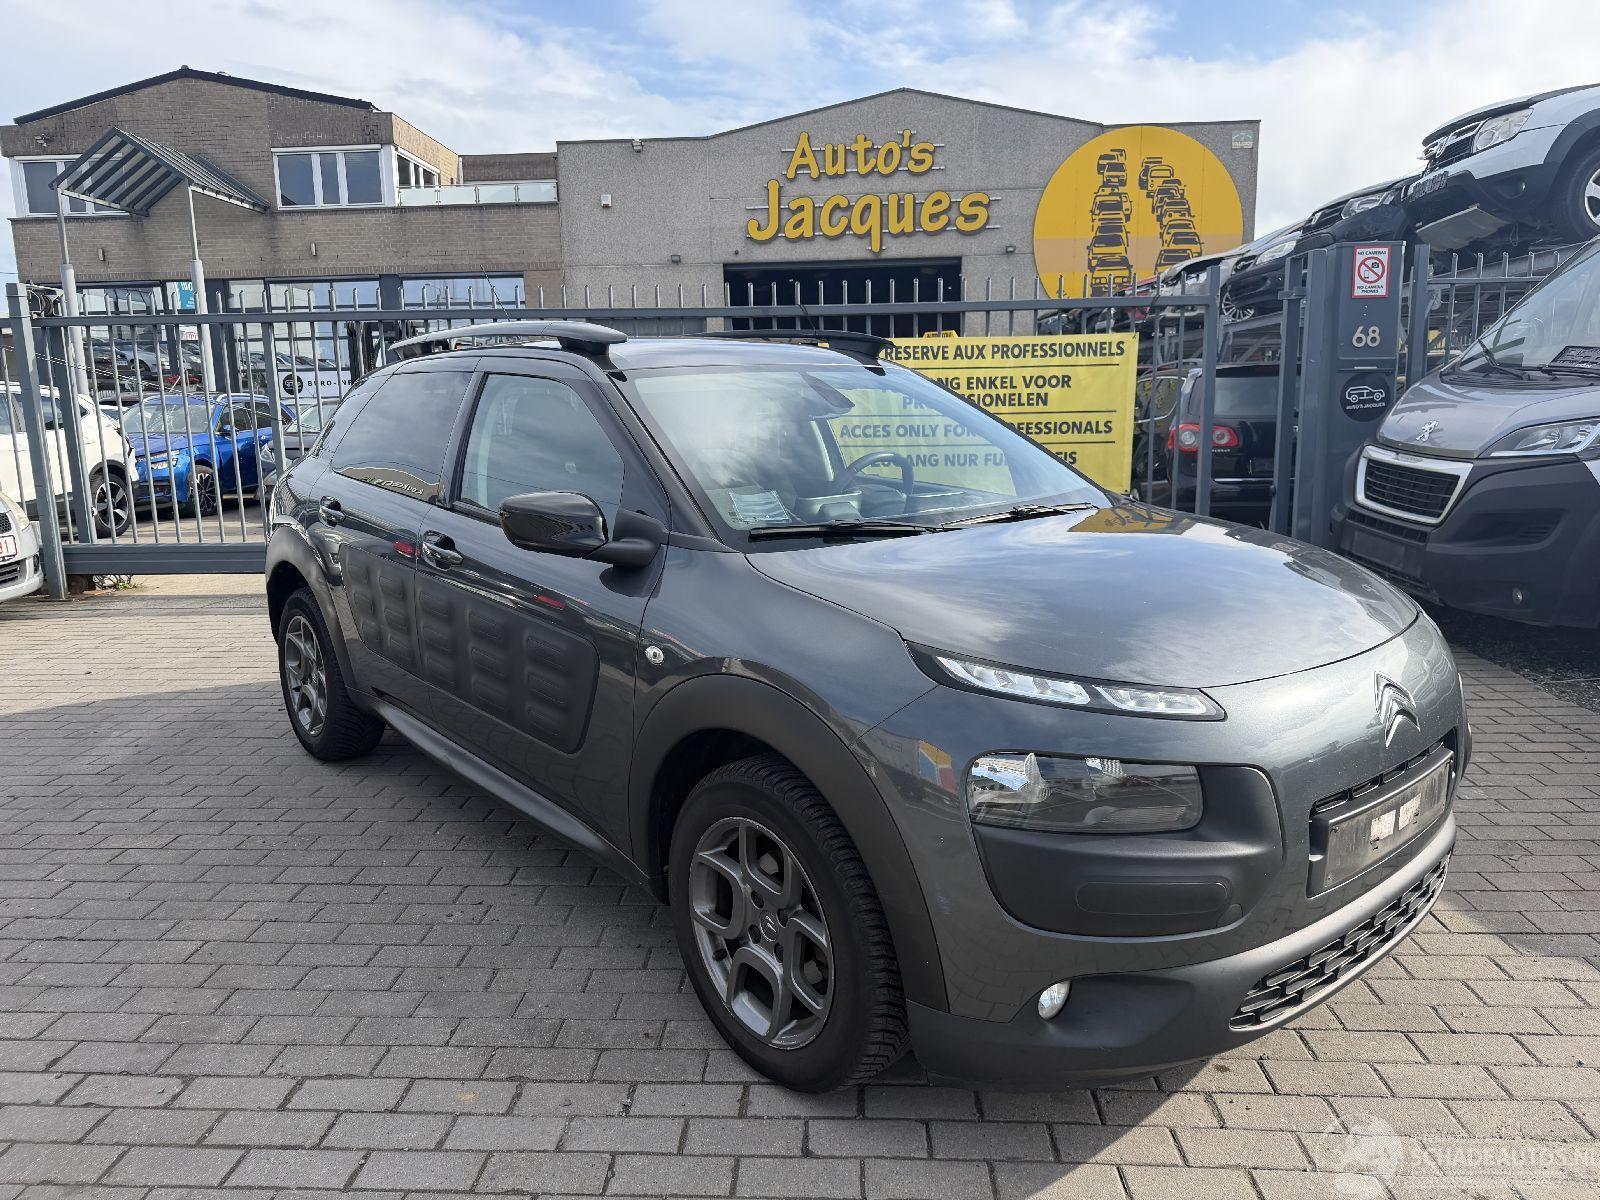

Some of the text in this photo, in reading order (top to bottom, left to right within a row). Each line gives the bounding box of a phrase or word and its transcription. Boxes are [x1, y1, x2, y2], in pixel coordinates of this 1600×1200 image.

[786, 129, 935, 179] Auto's
[747, 179, 990, 253] Jacques
[1352, 326, 1380, 347] 68
[884, 340, 1125, 360] RESERVE AUX PROFESSIONNELS
[966, 376, 1017, 391] ENKEL
[1022, 374, 1072, 389] VOOR
[840, 424, 891, 438] ACCES
[895, 424, 939, 438] ONLY
[1007, 420, 1113, 435] FESSIONALS
[944, 453, 979, 467] NUR
